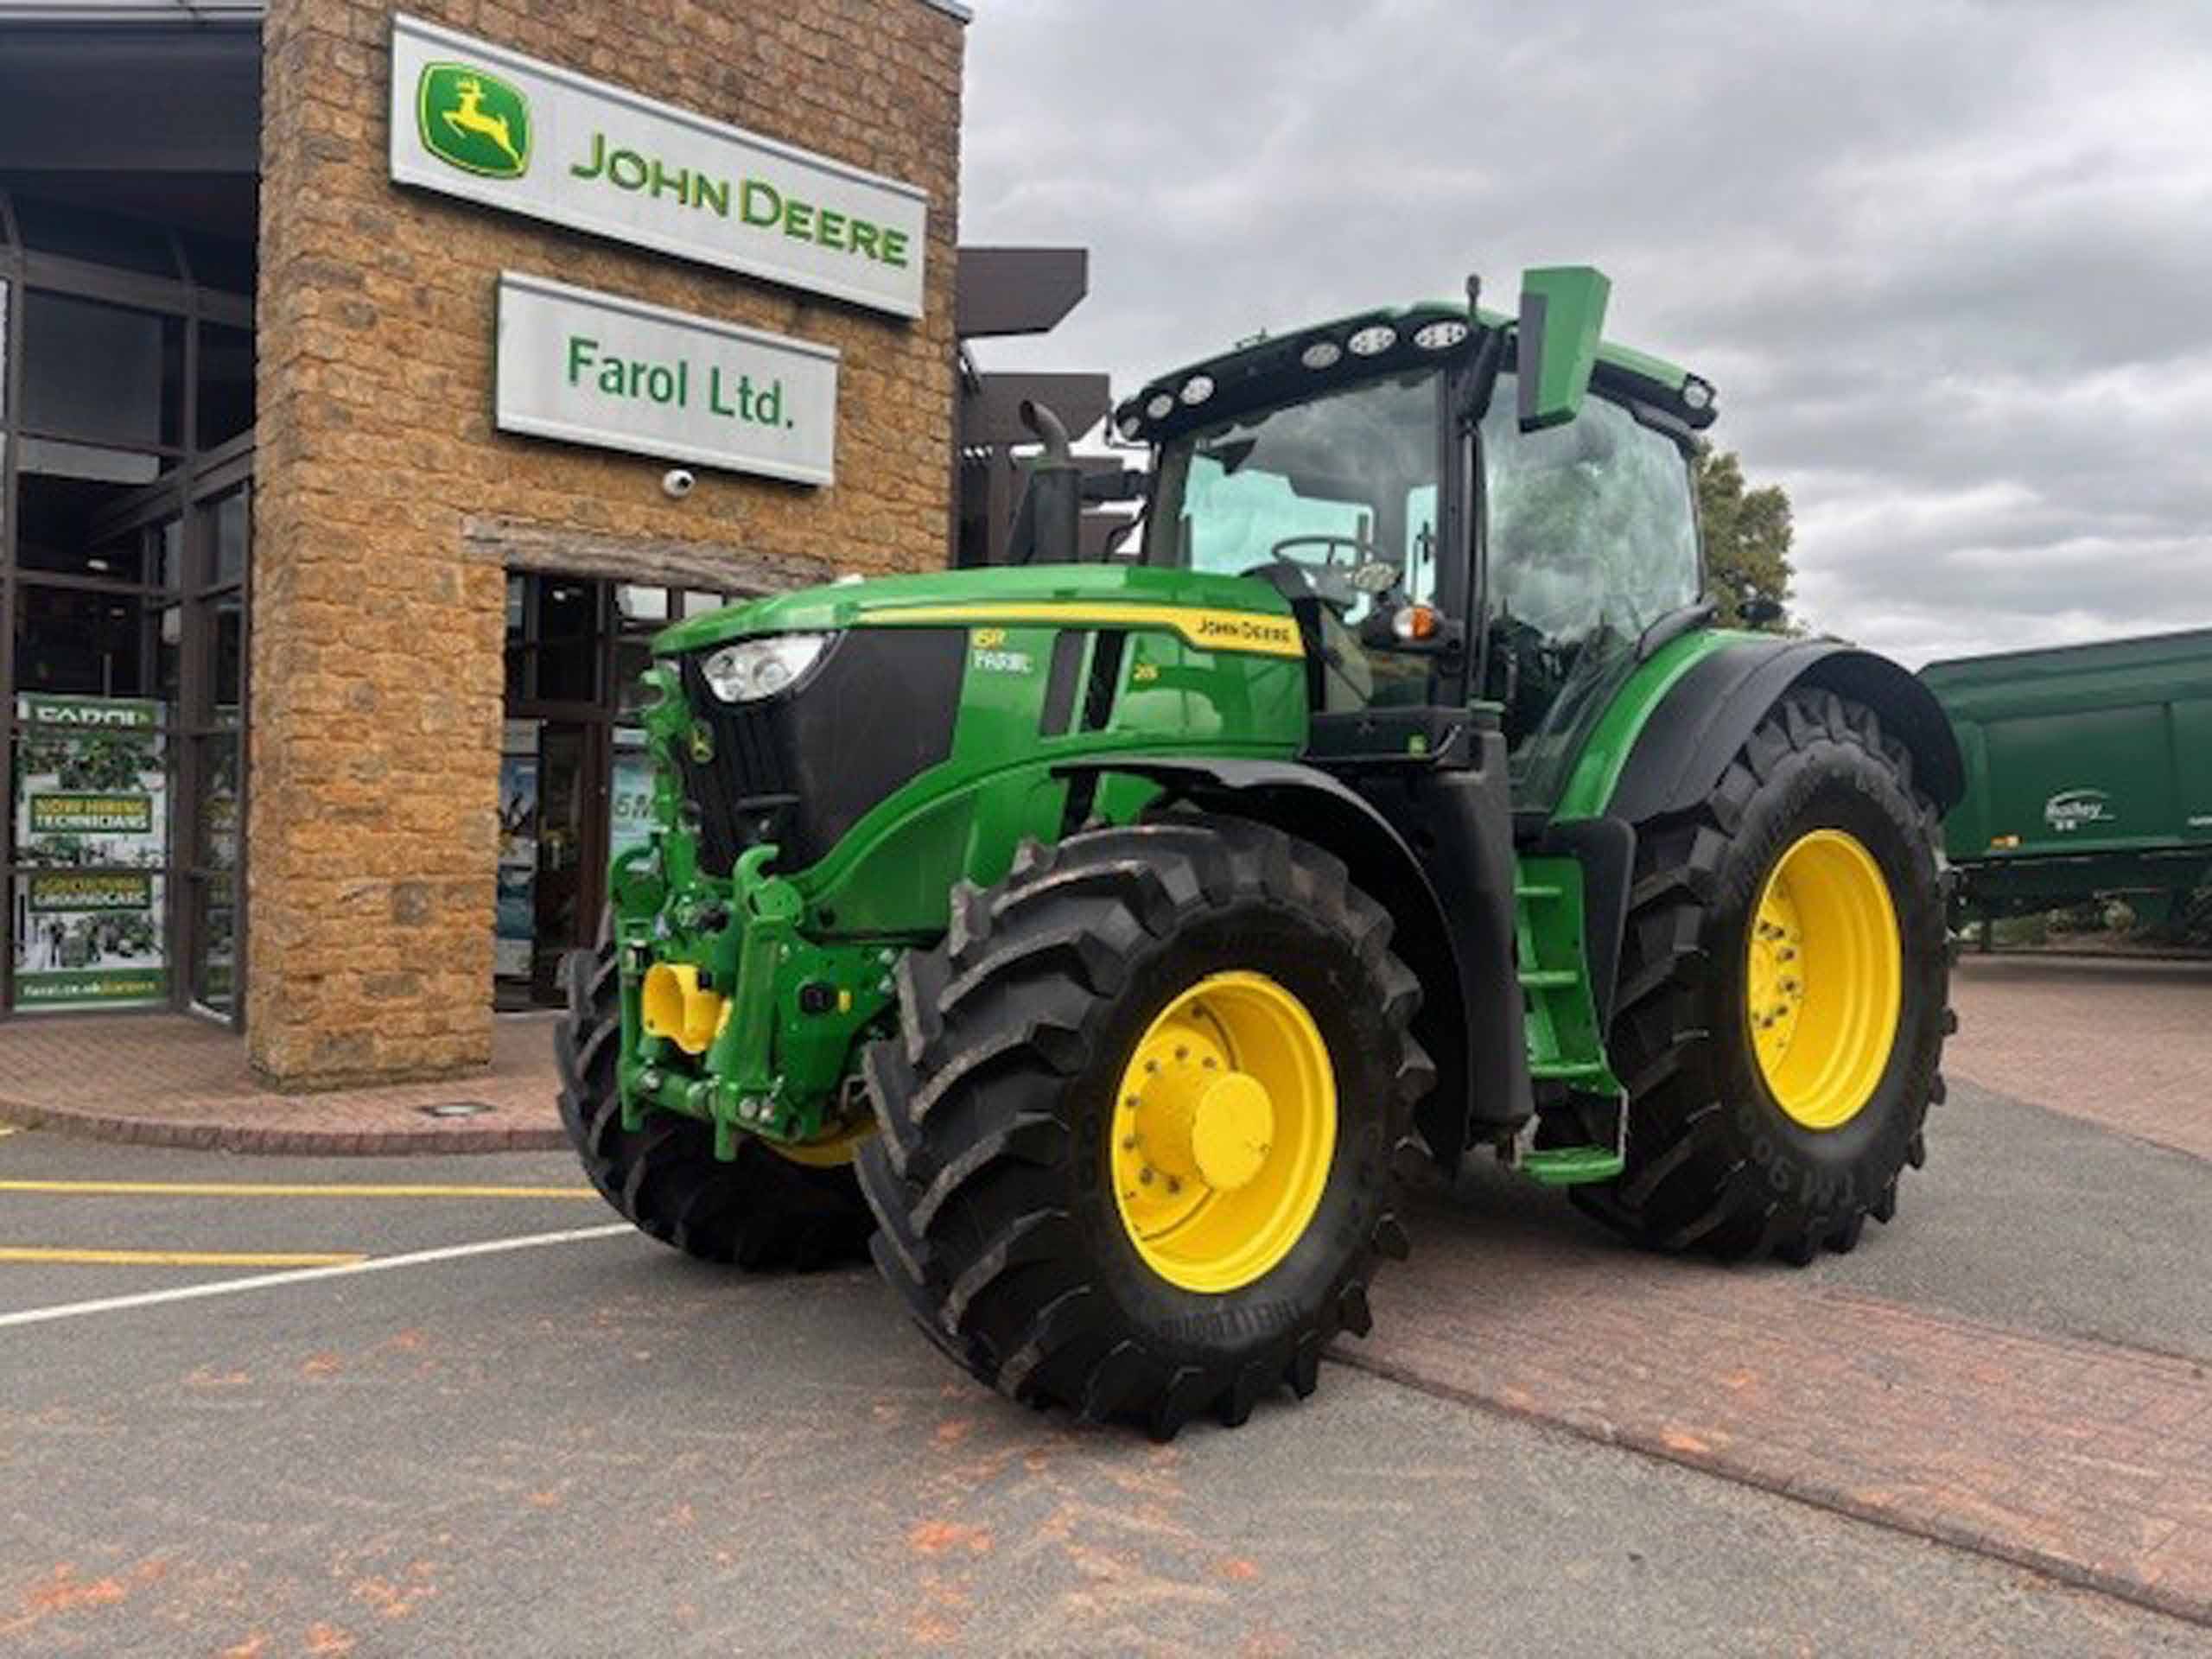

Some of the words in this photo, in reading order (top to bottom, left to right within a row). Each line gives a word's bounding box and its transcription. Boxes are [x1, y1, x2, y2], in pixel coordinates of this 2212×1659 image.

[570, 132, 731, 217] JOHN
[740, 179, 910, 267] DEERE
[569, 336, 690, 410] Farol
[709, 367, 795, 429] Ltd.
[1198, 616, 1239, 637] JOHN
[1243, 620, 1292, 643] DEERE
